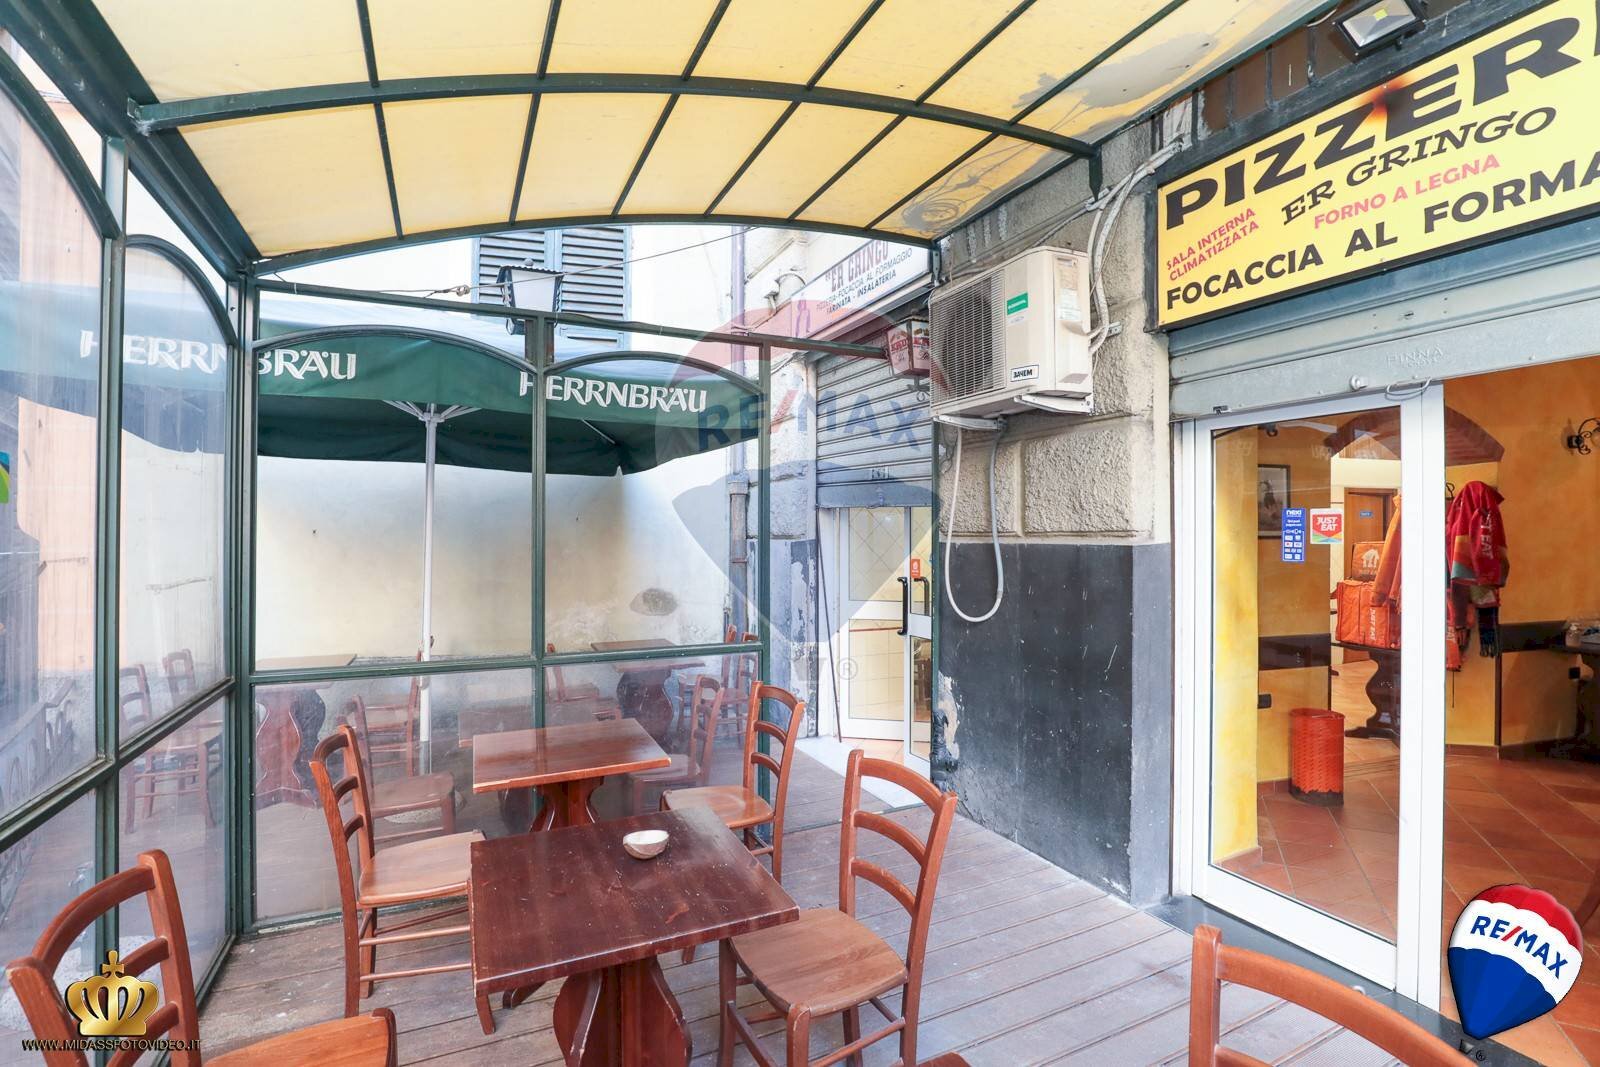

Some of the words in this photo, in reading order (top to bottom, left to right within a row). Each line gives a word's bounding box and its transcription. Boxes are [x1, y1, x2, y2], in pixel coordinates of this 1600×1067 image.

[1166, 0, 1600, 230] PIZZER
[1282, 180, 1335, 226] ER
[1346, 106, 1557, 186] GRINGO
[1313, 193, 1387, 229] FORNO
[1392, 186, 1409, 204] A
[1415, 154, 1500, 195] LEGNA
[875, 247, 913, 276] FORMAGGIO
[1165, 245, 1196, 271] SALA
[1197, 207, 1256, 250] INTERNA
[1166, 244, 1324, 311] FOCACCIA
[1345, 221, 1399, 258] AL
[1168, 220, 1259, 282] CLIMATIZZATA
[857, 270, 897, 298] INSALATERIA
[1316, 516, 1338, 525] JUST
[1320, 524, 1337, 532] EAT
